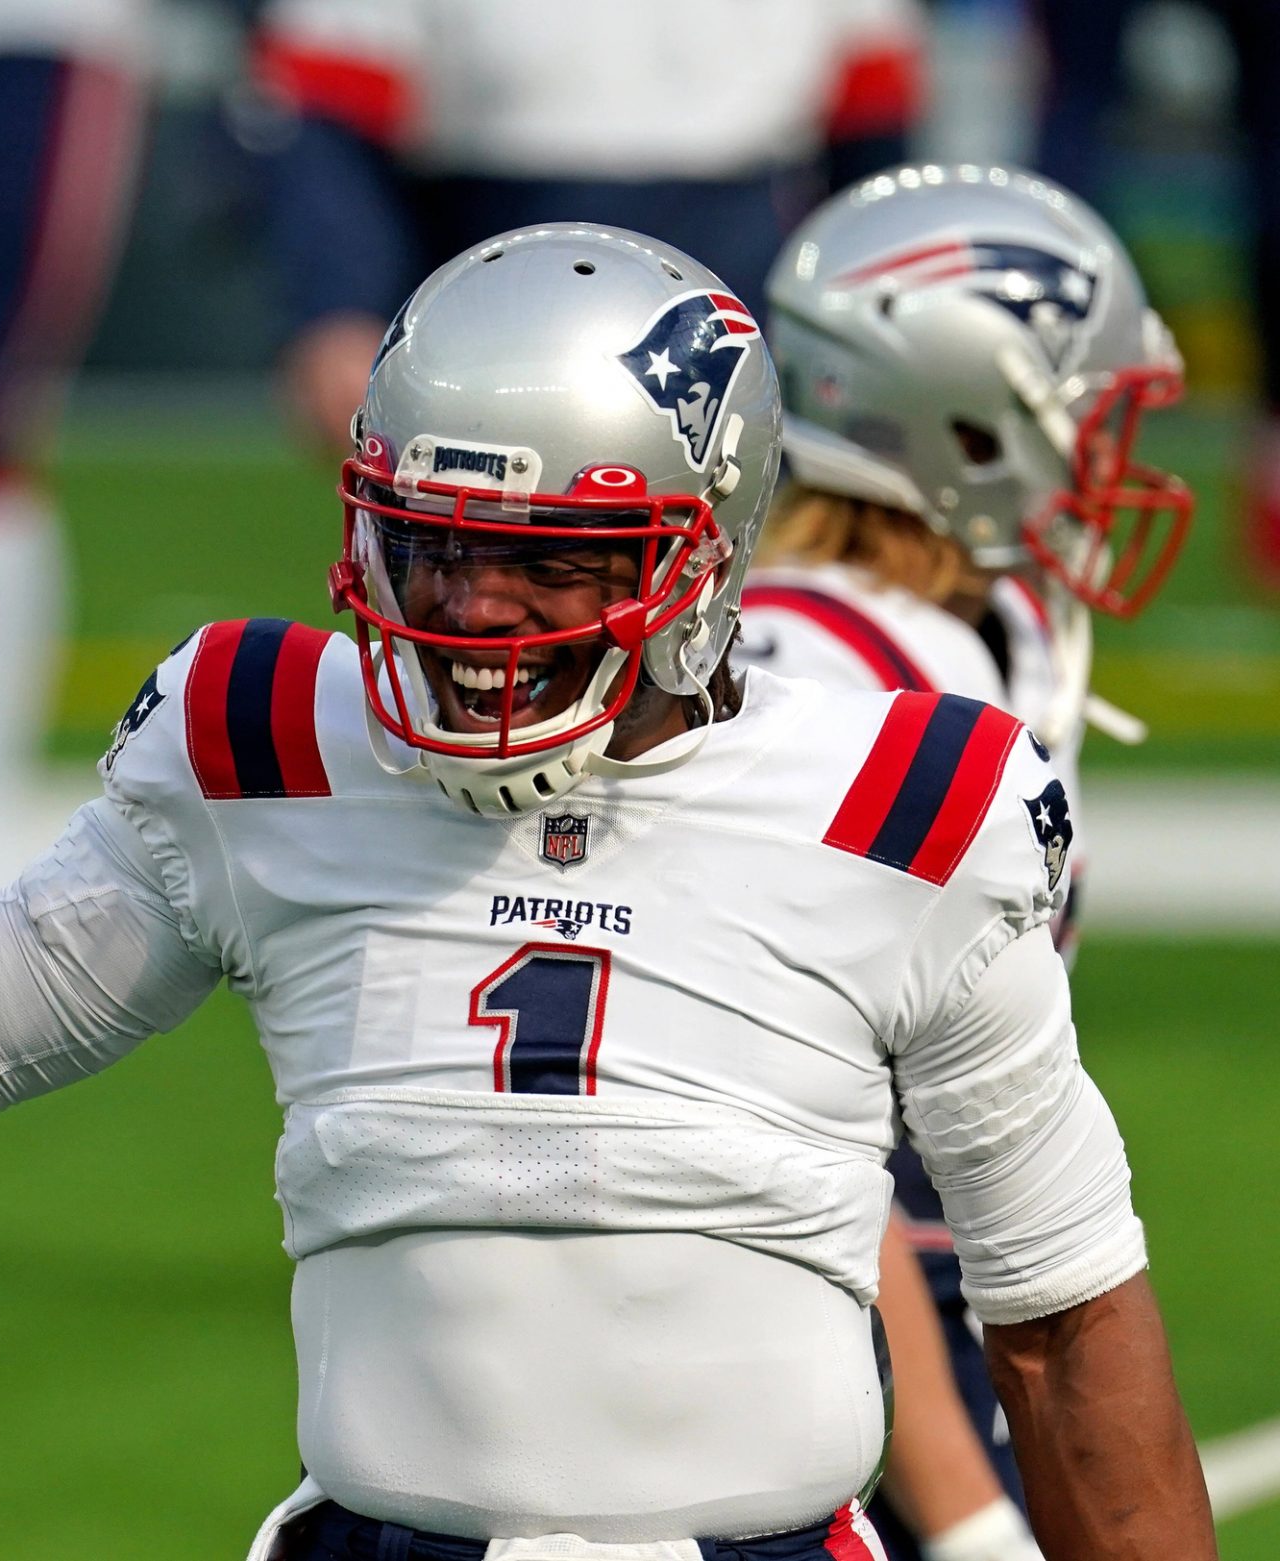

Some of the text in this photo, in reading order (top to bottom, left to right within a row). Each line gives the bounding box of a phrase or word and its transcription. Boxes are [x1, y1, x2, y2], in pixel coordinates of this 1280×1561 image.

[433, 446, 508, 481] PATRIOTS
[546, 834, 583, 860] NFL
[490, 895, 633, 935] PATRIOTS
[468, 941, 612, 1096] 1
